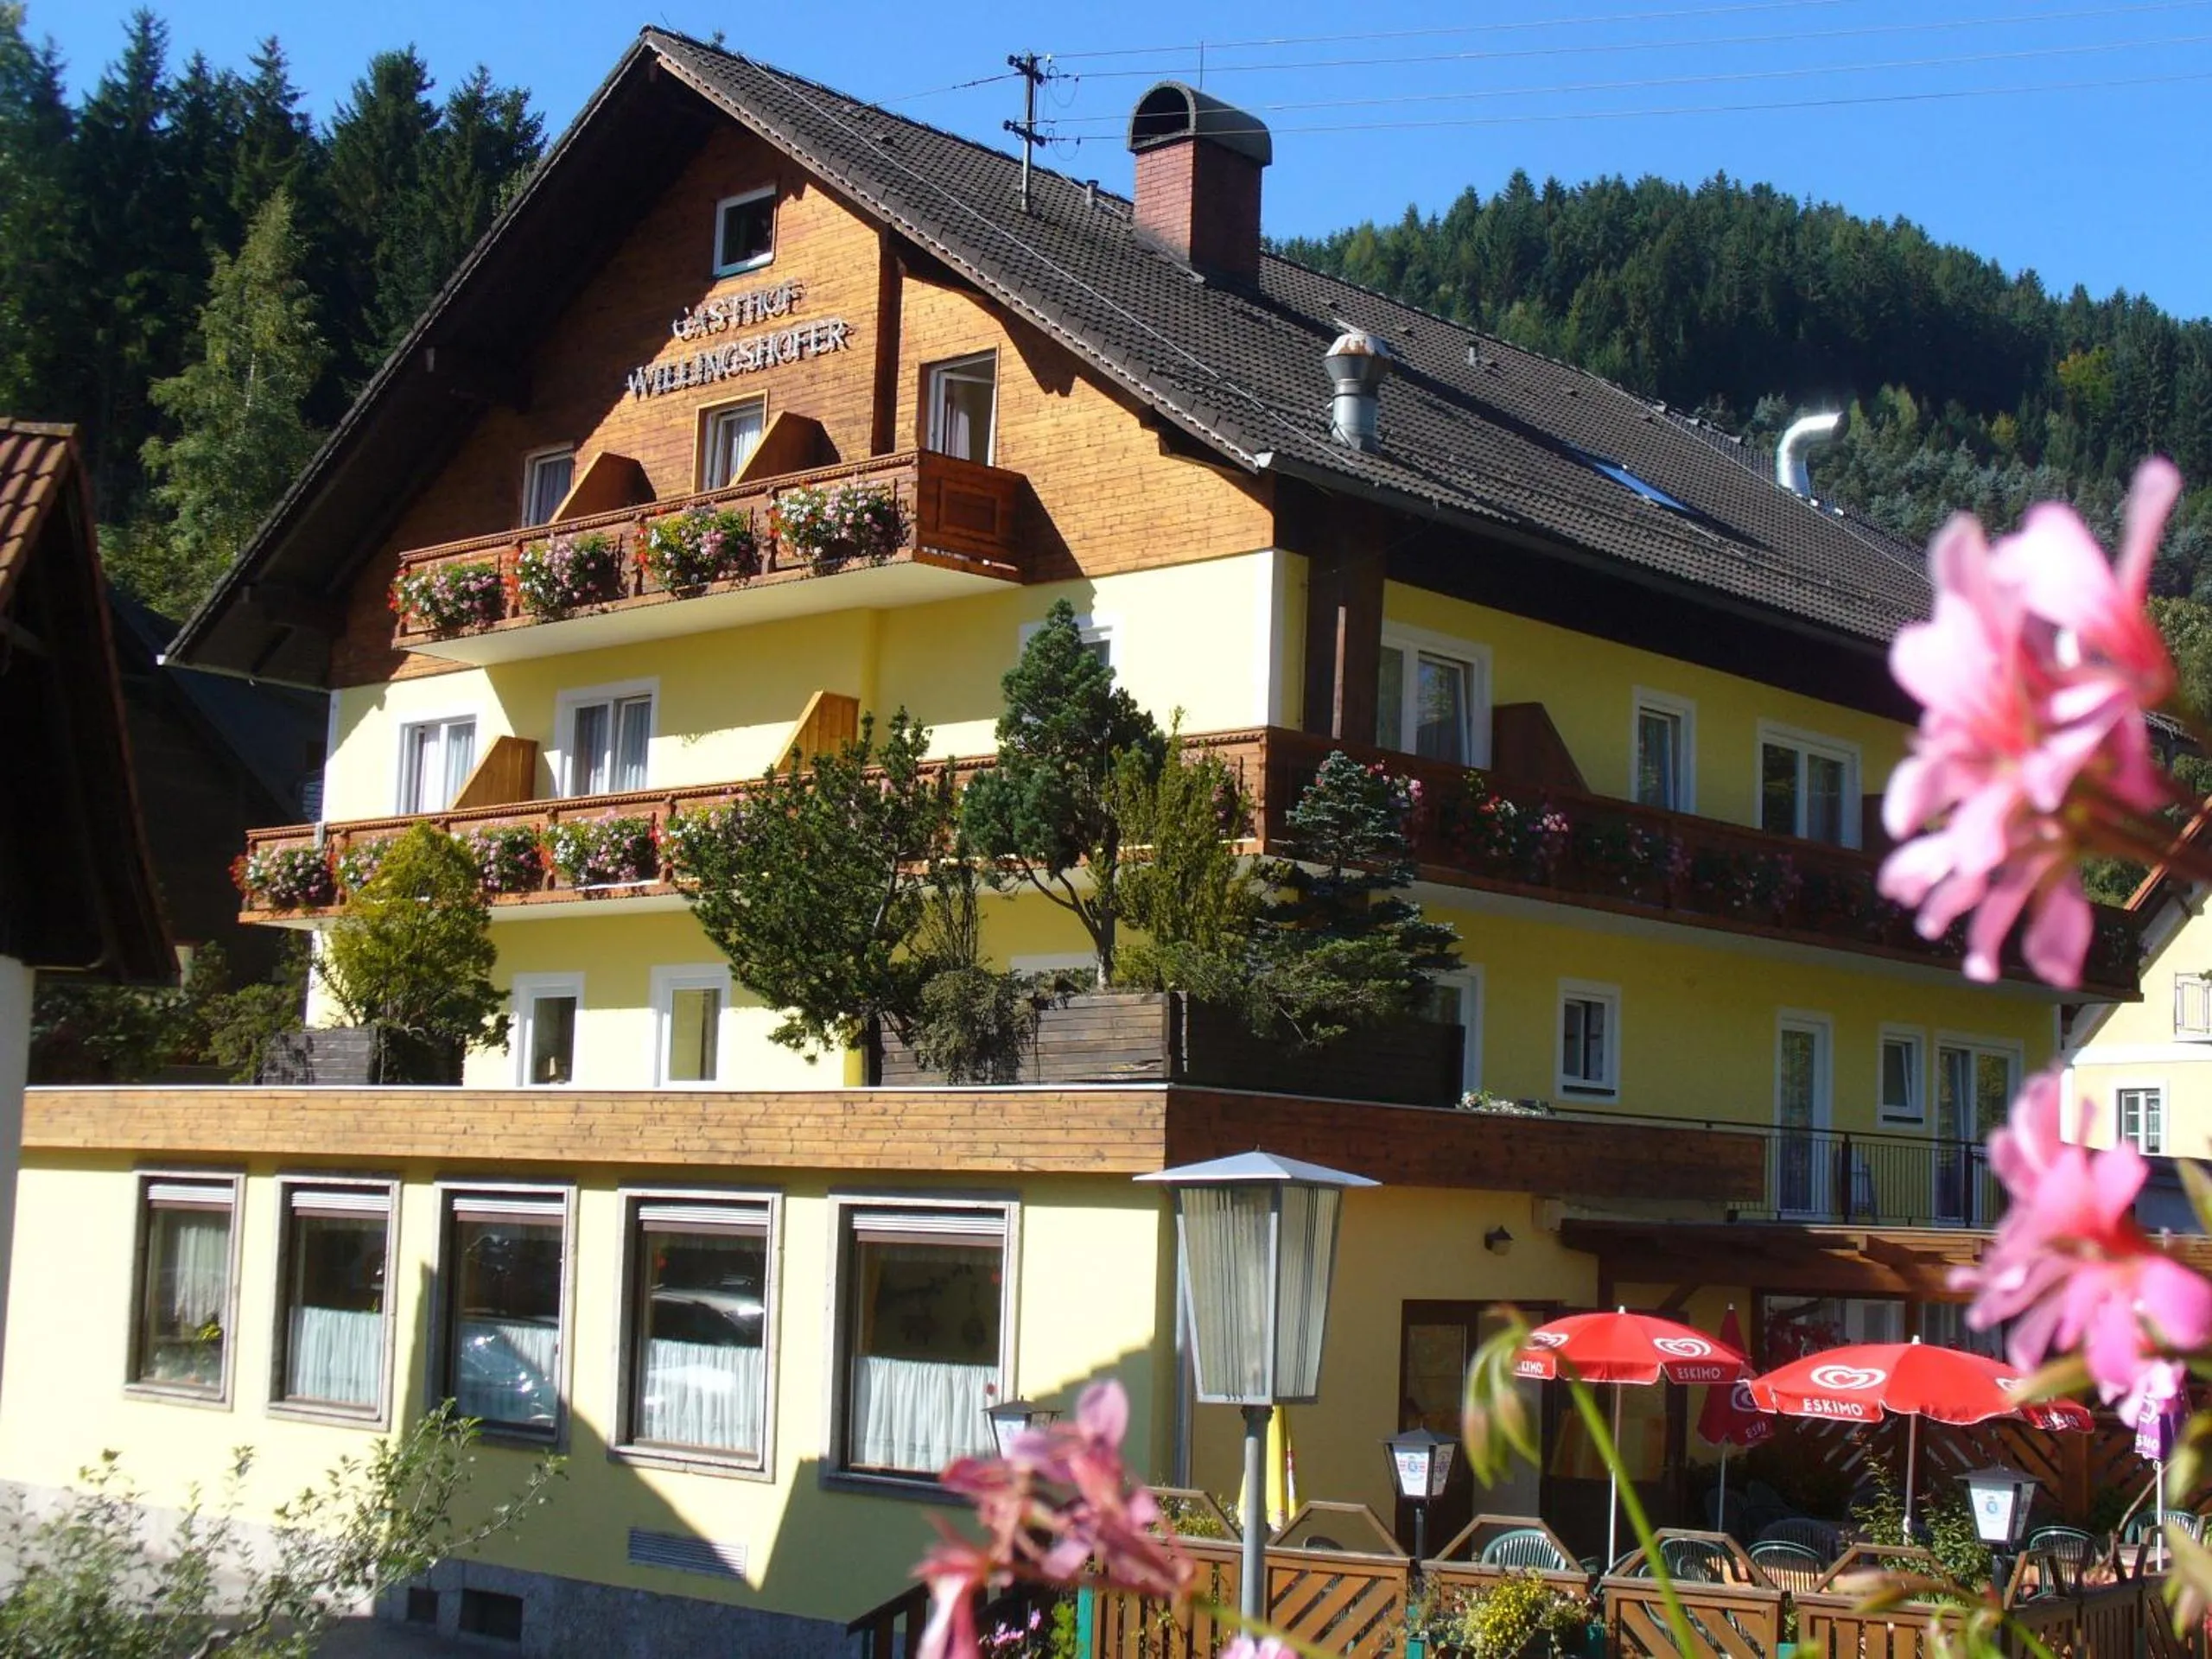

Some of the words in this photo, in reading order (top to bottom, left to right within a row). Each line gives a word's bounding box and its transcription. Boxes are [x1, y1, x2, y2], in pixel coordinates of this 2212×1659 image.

[671, 277, 806, 340] GASTHOF
[626, 317, 855, 396] WILLINGSHOFER
[1677, 1367, 1721, 1381] ESKIMO
[1802, 1398, 1863, 1416] ESKIMO
